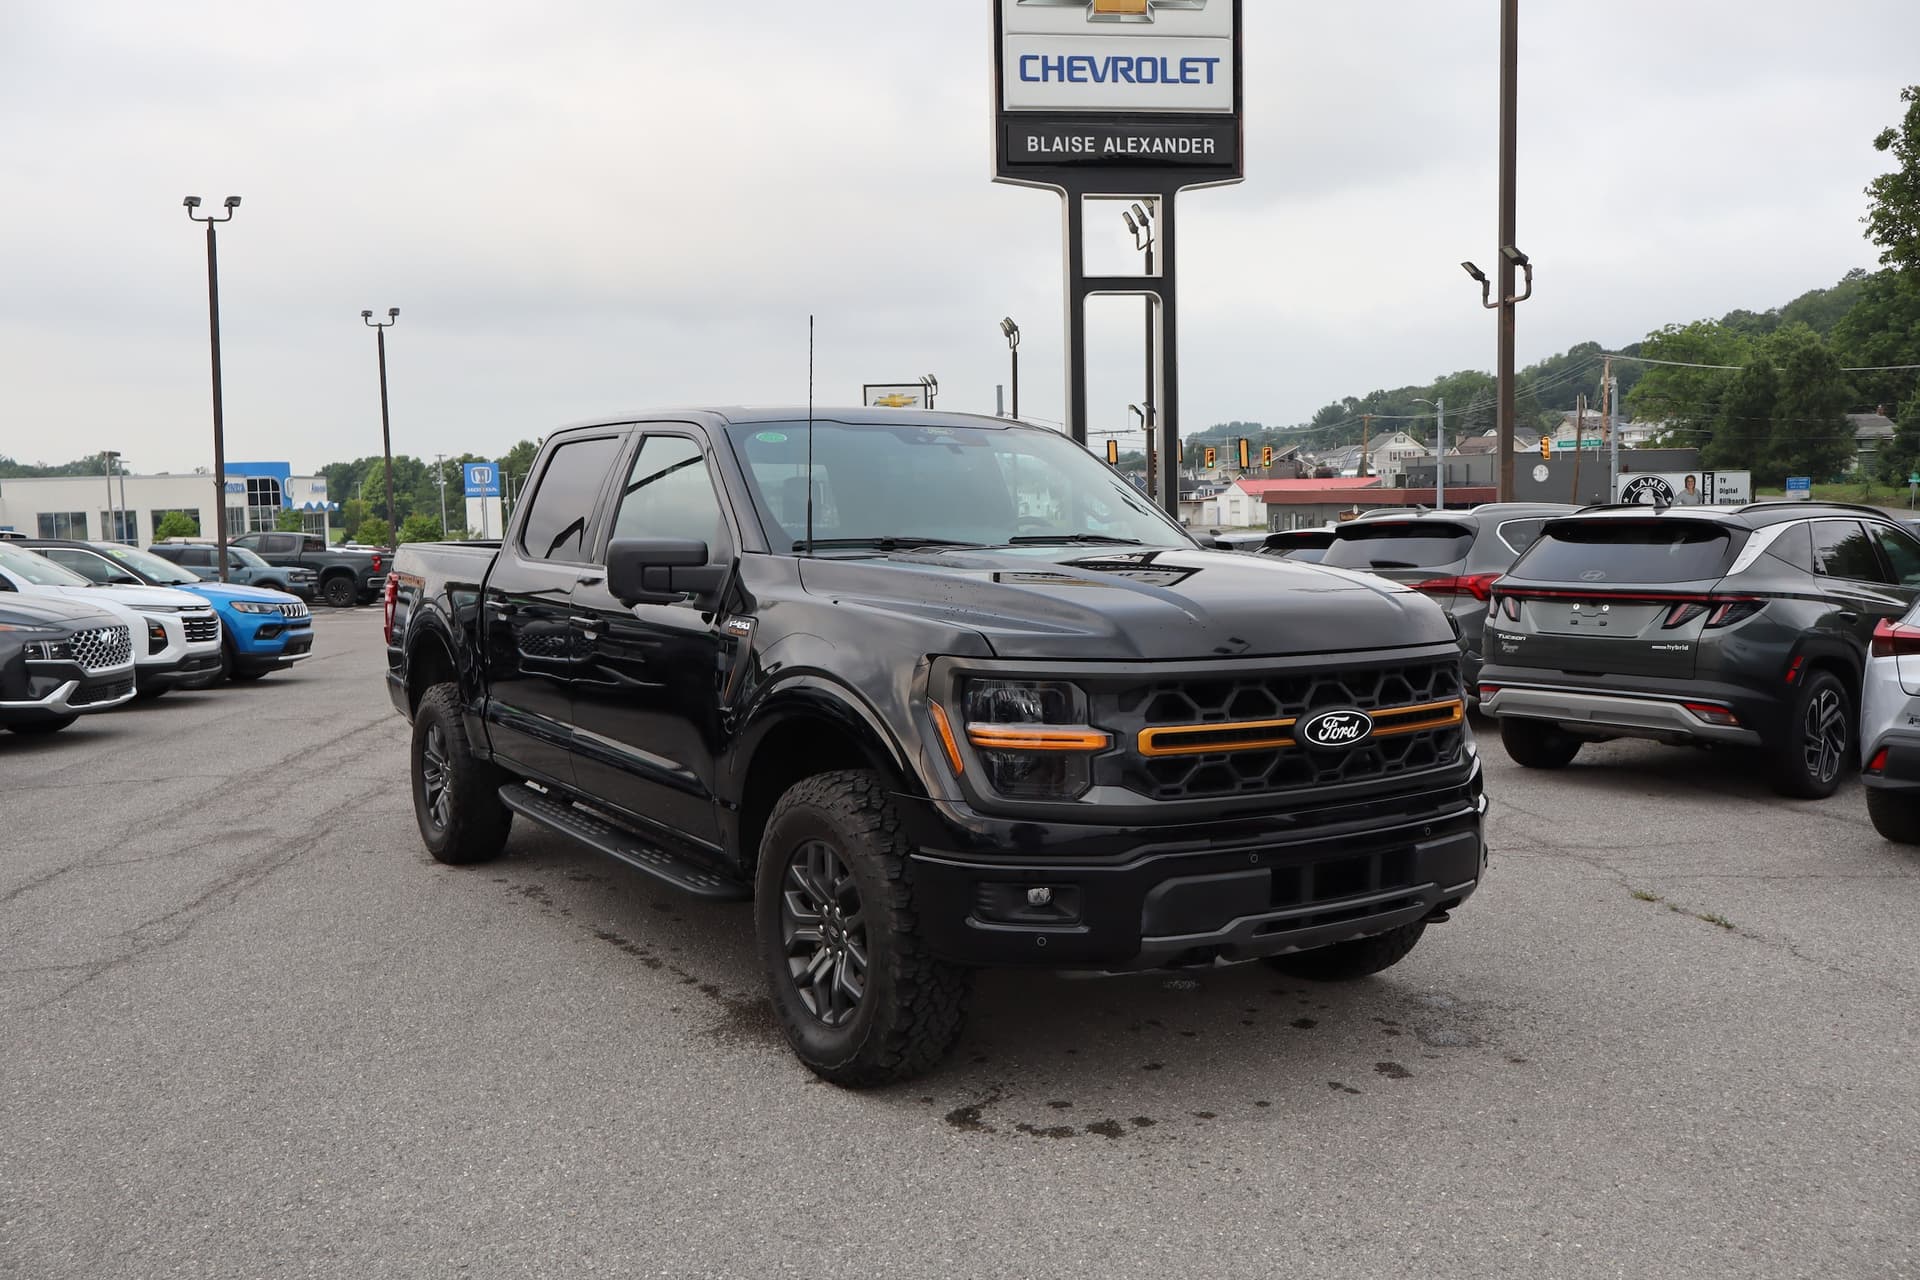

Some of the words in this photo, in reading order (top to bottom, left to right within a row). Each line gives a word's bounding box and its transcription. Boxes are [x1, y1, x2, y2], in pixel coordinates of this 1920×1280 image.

[1019, 54, 1220, 84] CHEVROLET
[1027, 136, 1096, 153] BLAISE
[1103, 137, 1215, 154] ALEXANDER
[1629, 478, 1667, 492] LAMB
[1719, 487, 1738, 495] Digital
[1497, 633, 1527, 641] Tucson
[1318, 716, 1360, 741] Ford
